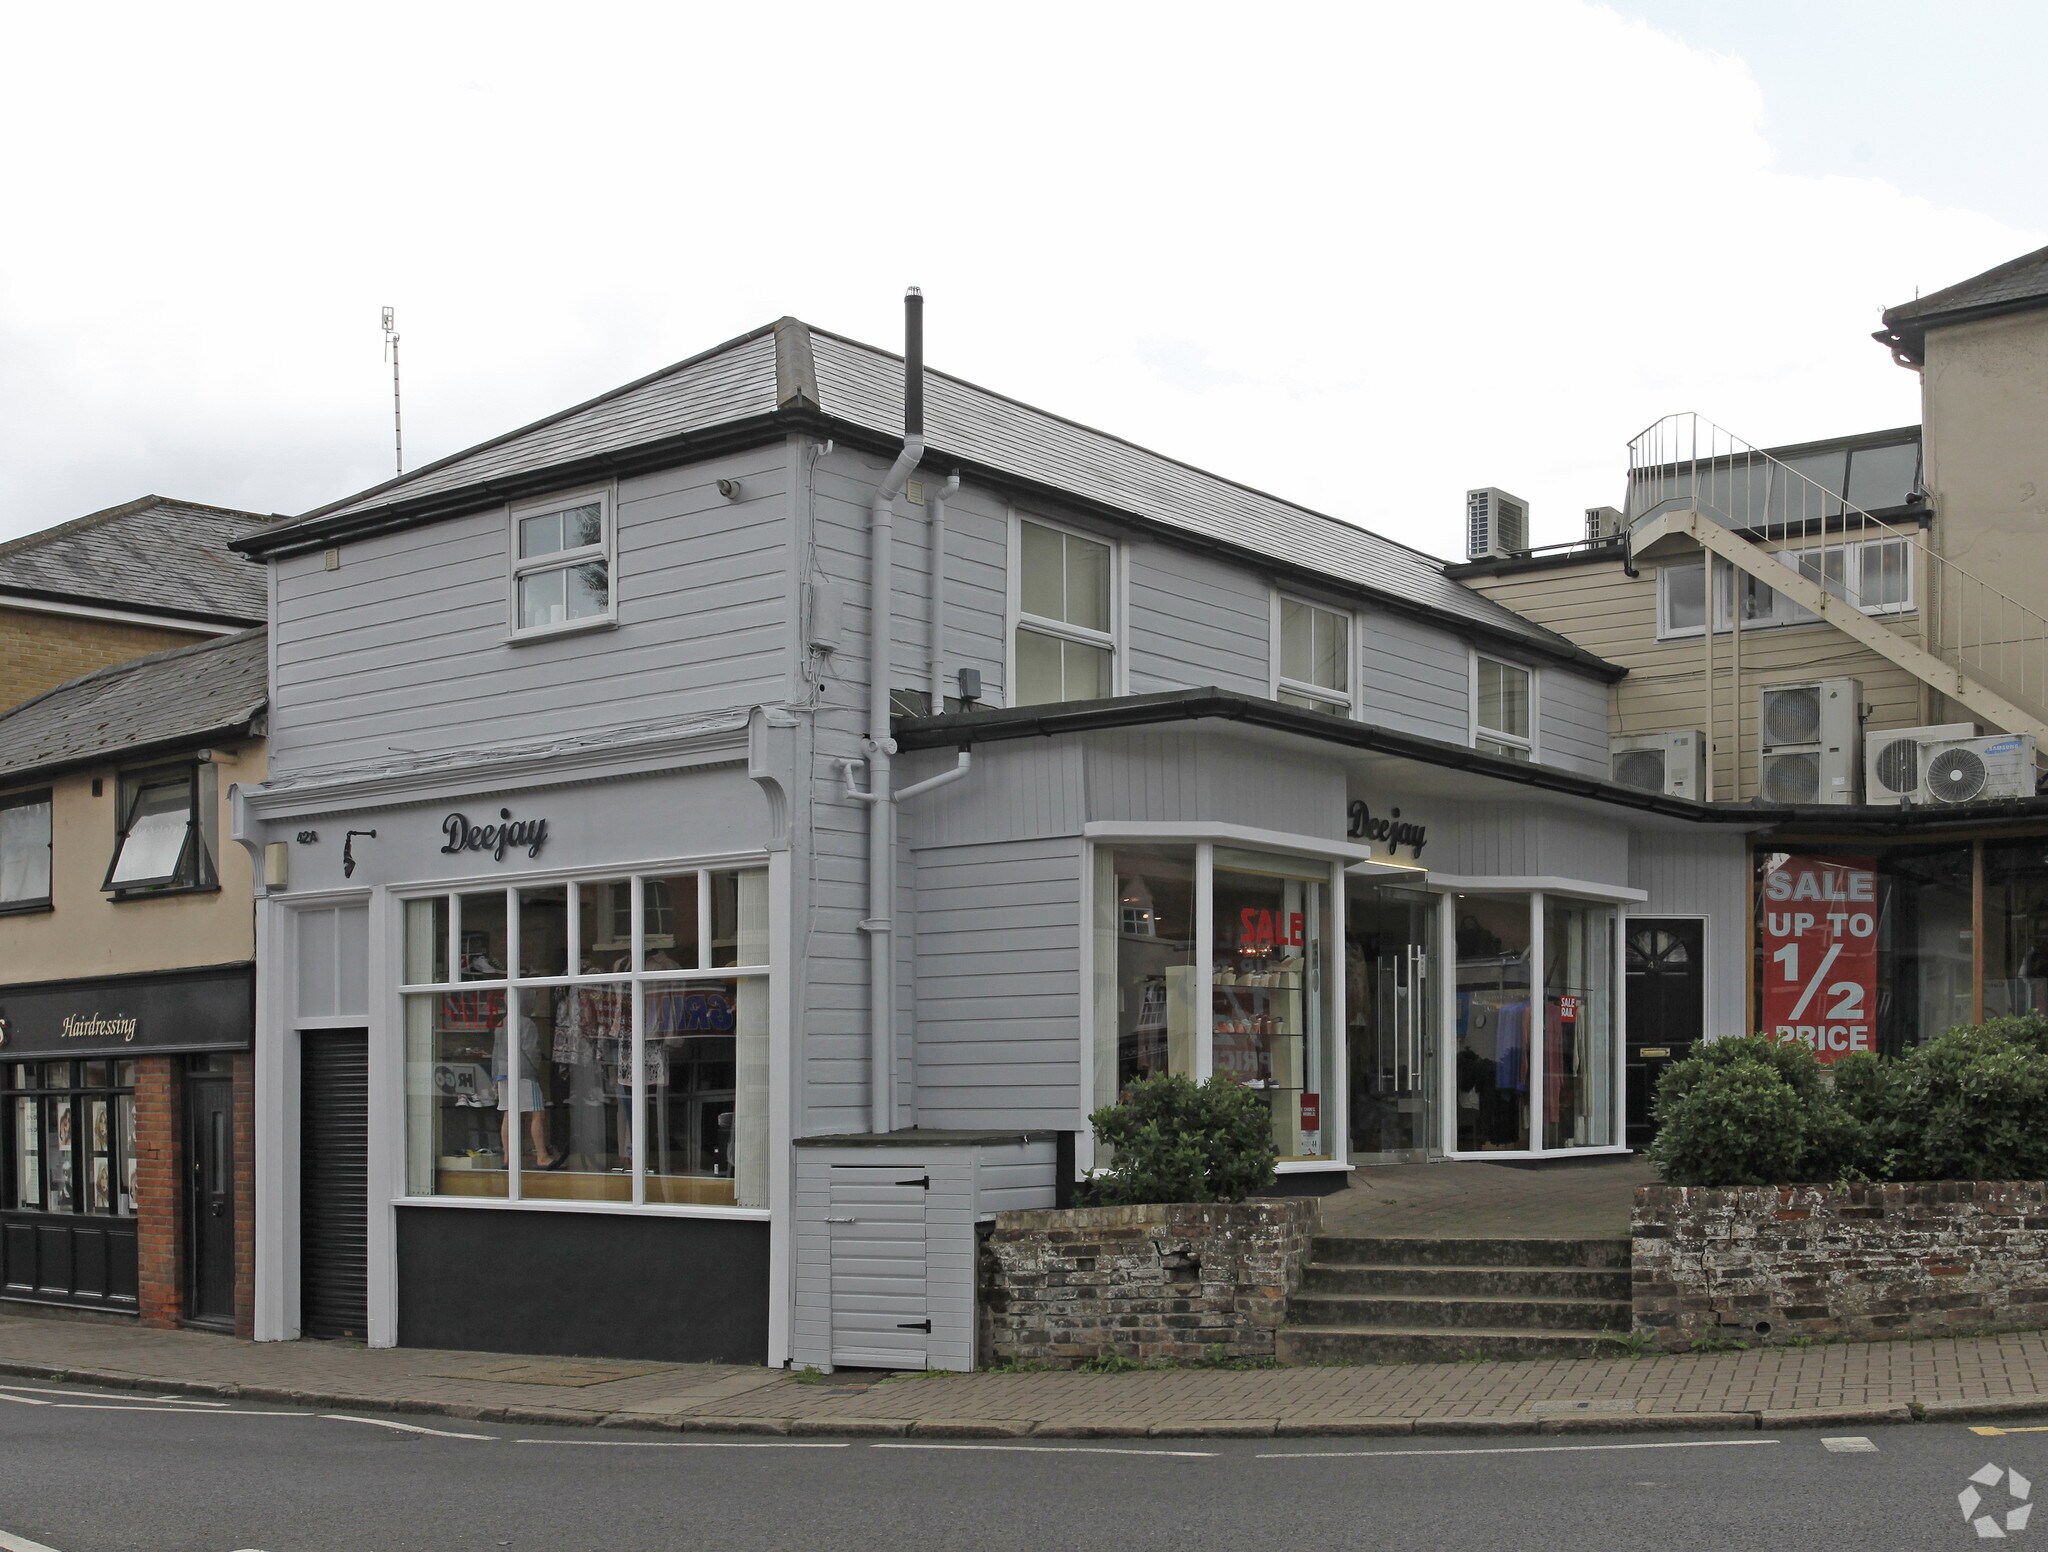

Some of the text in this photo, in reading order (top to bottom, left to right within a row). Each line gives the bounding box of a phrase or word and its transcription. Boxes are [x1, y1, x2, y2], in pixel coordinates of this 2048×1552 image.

[296, 830, 318, 844] 42A
[441, 808, 548, 862] Deejay
[1347, 800, 1427, 859] Deejay
[1766, 871, 1874, 902] SALE
[1240, 908, 1305, 947] SALE
[1768, 912, 1874, 938] UP TO
[1773, 943, 1865, 1020] 1/2
[1561, 997, 1575, 1008] SALE
[61, 1012, 137, 1041] Hairdressing
[1775, 1025, 1869, 1051] PRICE
